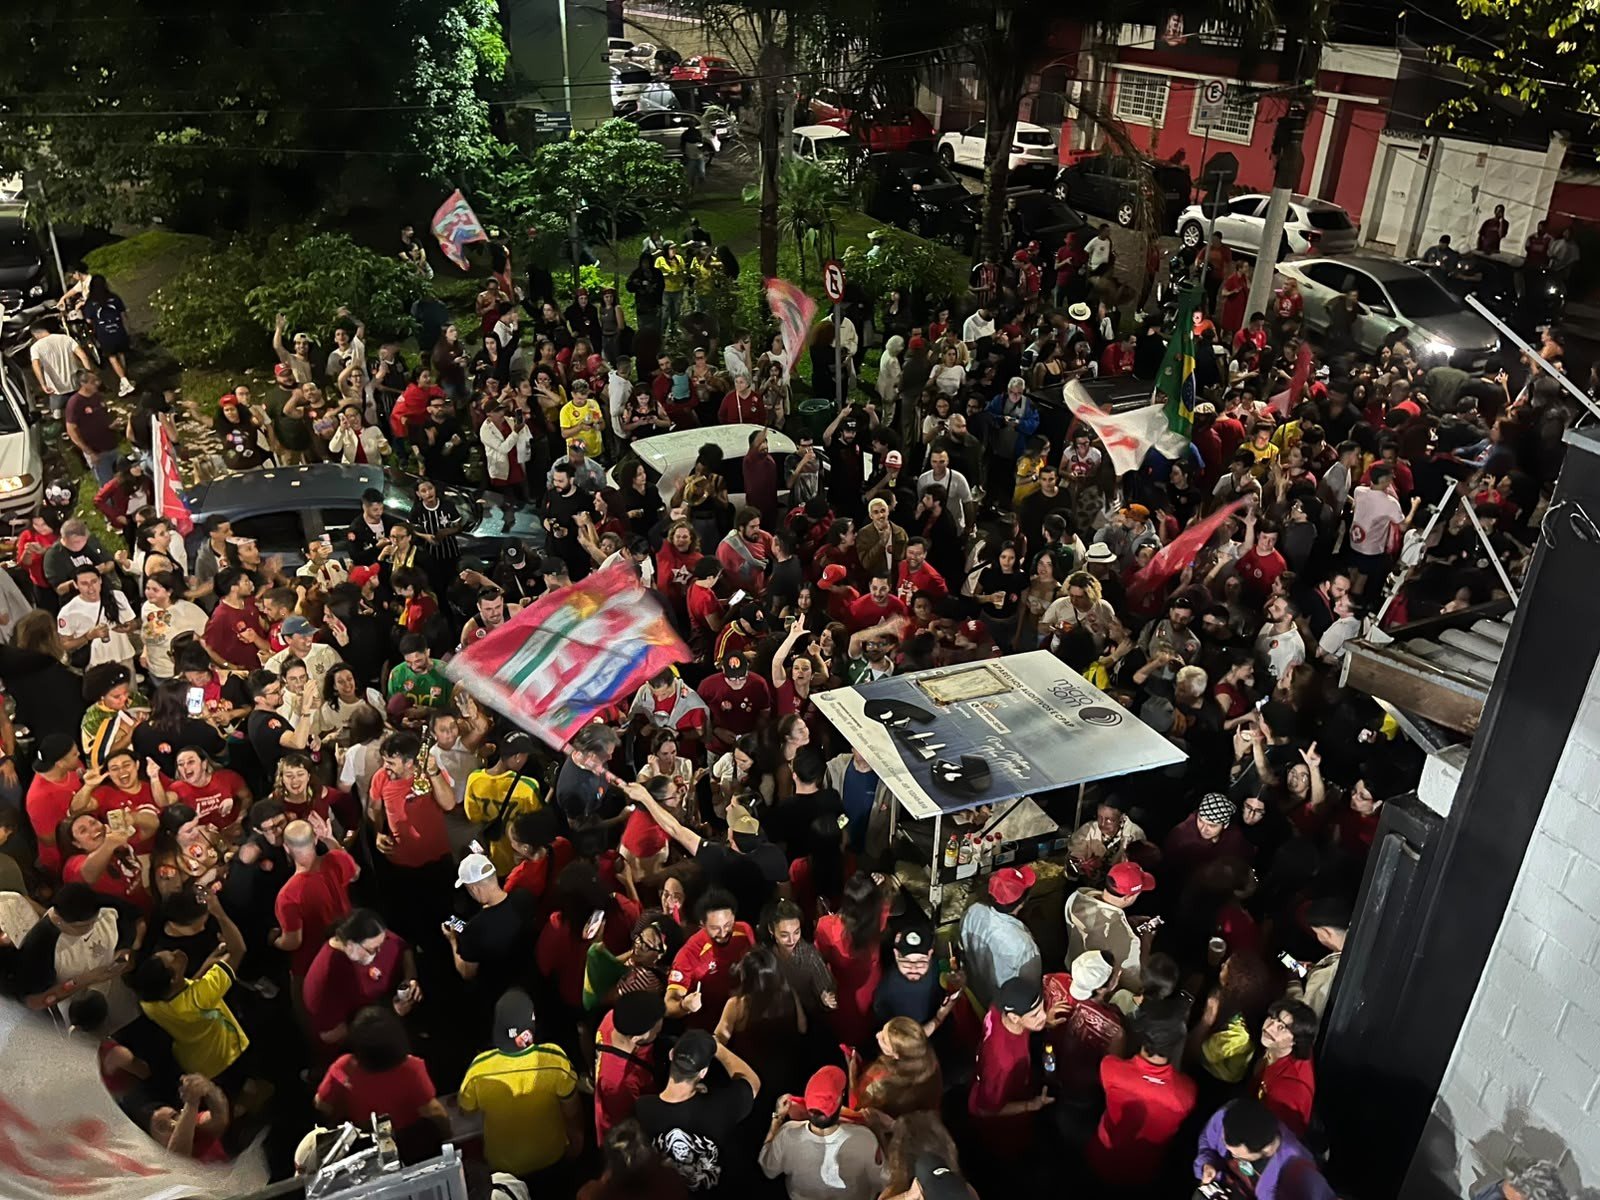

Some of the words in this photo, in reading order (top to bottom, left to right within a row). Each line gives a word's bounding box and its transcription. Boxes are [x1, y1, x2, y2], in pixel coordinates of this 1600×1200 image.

[991, 663, 1024, 690] APARELHOS
[1021, 688, 1051, 713] AUDITIVOS
[1054, 712, 1075, 728] CPAP
[1047, 687, 1081, 708] som
[1053, 678, 1093, 705] micro
